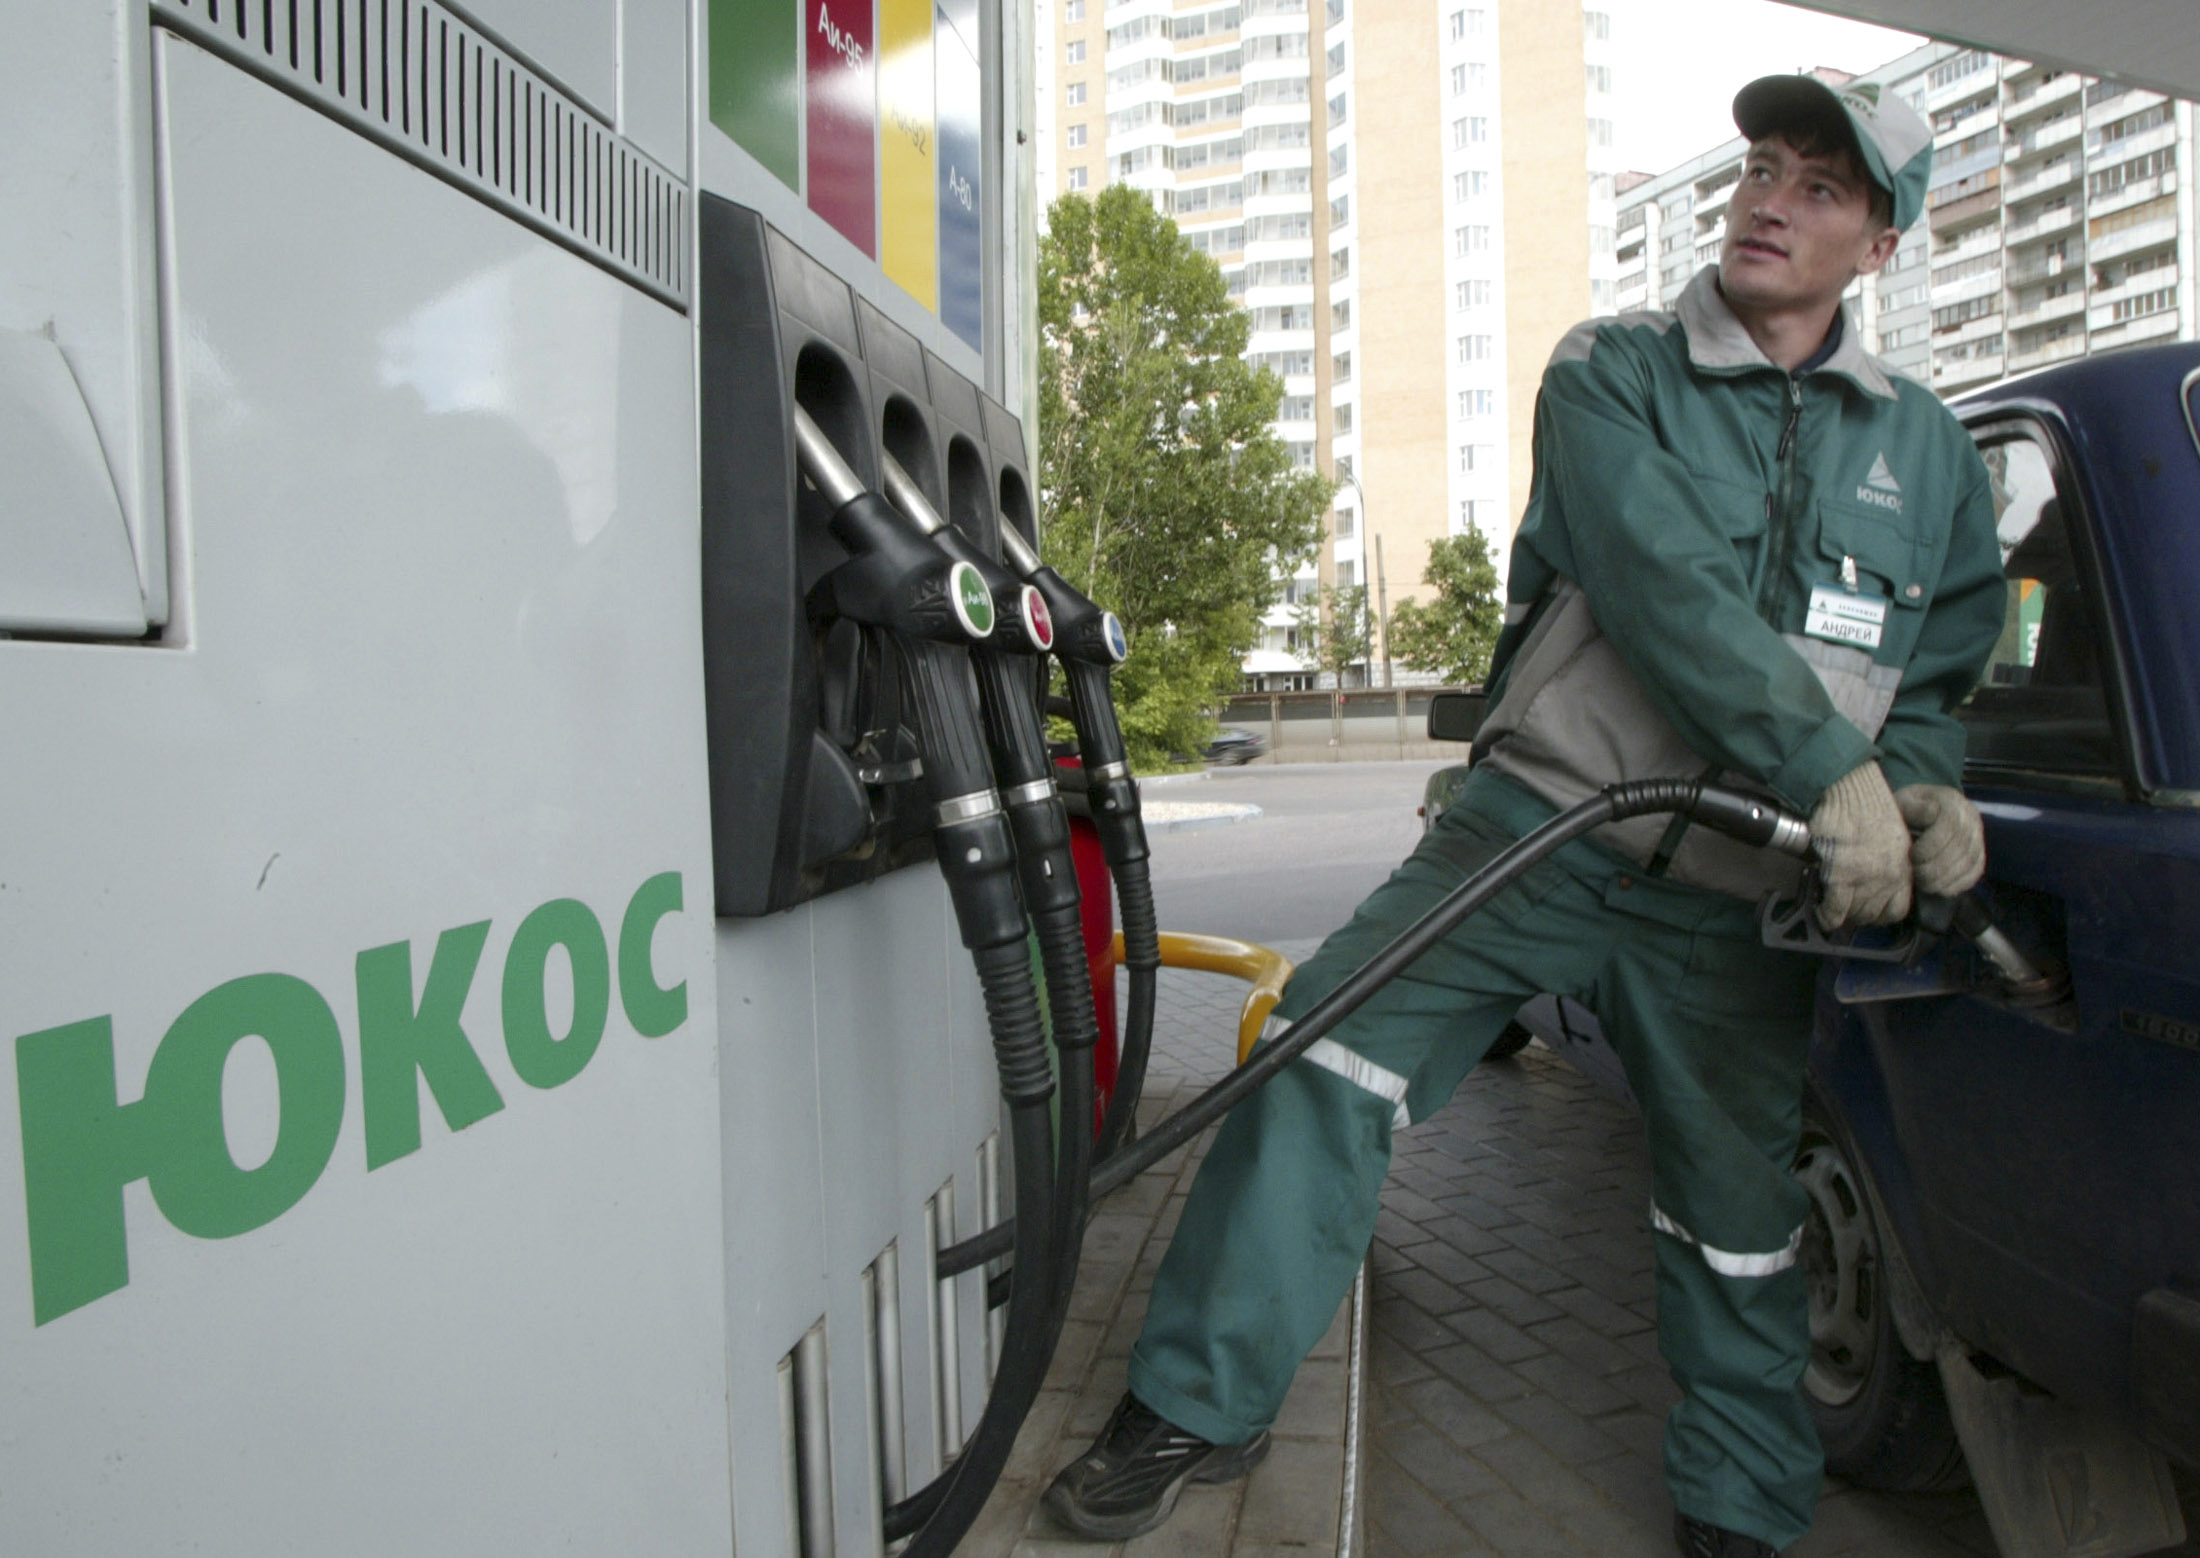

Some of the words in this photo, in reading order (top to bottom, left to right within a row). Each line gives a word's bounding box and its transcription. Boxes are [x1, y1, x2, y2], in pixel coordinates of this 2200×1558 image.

[818, 1, 864, 79] Аи-95
[949, 165, 972, 211] А-80
[1820, 619, 1872, 641] АНДРЕЙ
[15, 871, 688, 1328] ЮКОС
